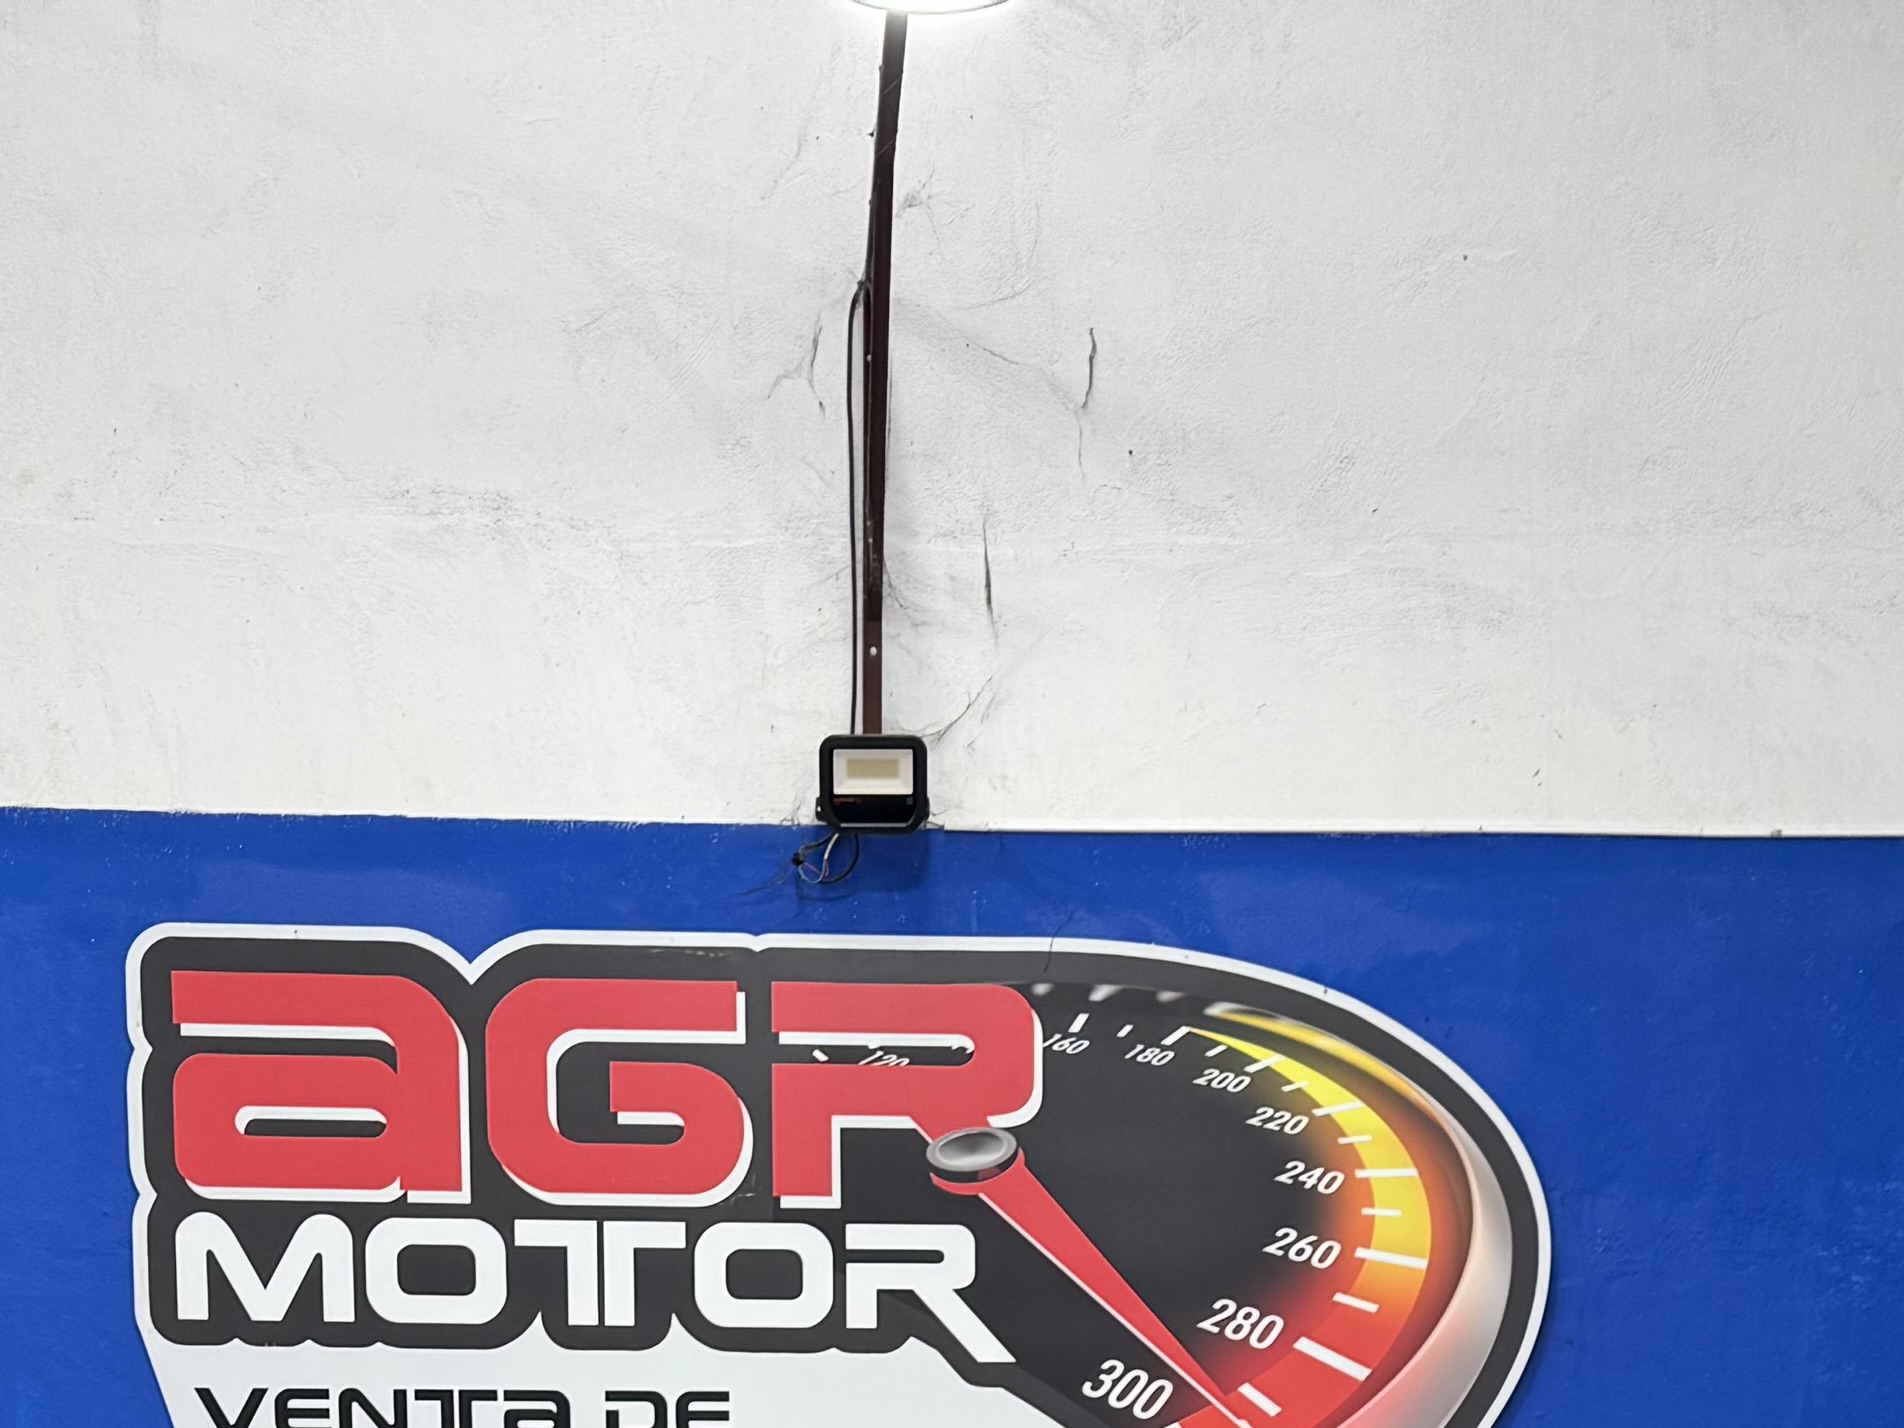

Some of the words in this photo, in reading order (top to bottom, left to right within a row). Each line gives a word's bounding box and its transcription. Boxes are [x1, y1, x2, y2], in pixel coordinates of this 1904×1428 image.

[1042, 1033, 1090, 1055] 160
[1124, 1043, 1175, 1066] 180
[1192, 1068, 1251, 1093] 200
[1245, 1106, 1309, 1135] 220
[1274, 1160, 1345, 1194] 240
[1262, 1227, 1342, 1269] 260
[175, 1212, 1016, 1363] MOTOR
[1196, 1298, 1285, 1350] 280
[1081, 1359, 1174, 1420] 300
